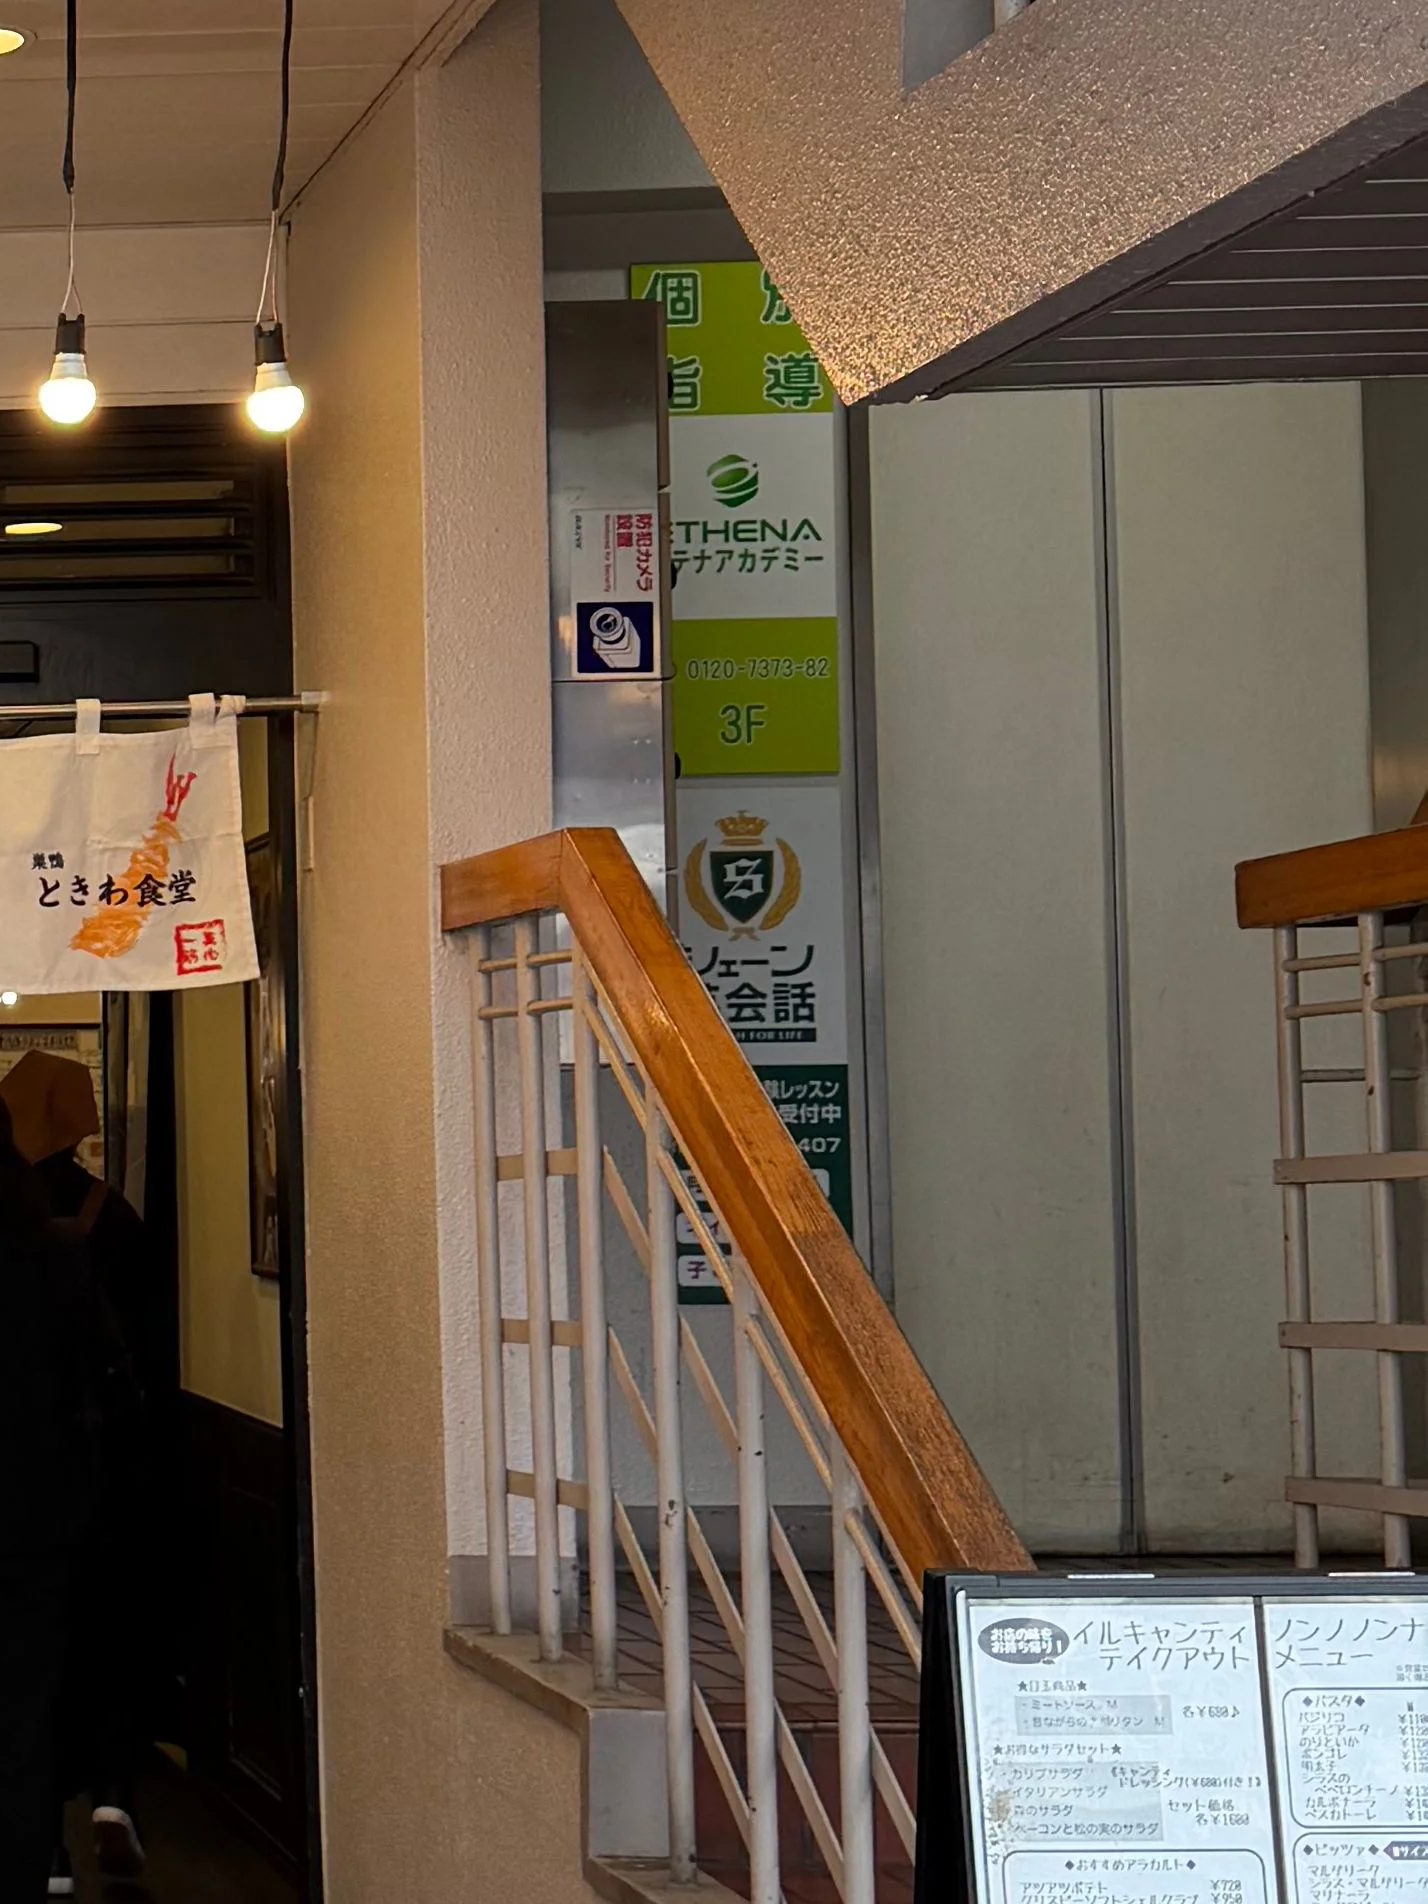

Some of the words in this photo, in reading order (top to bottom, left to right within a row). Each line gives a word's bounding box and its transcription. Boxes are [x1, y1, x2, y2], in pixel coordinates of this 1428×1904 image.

[670, 547, 824, 574] テナアカデミー
[687, 657, 830, 680] 0120-7373-82
[719, 704, 767, 745] 3F
[38, 869, 197, 908] ときわ食堂
[709, 980, 817, 1025] 会話
[1073, 1619, 1248, 1645] イルキャンティ
[1099, 1645, 1251, 1671] テイクアウト
[1274, 1644, 1374, 1670] メニュー
